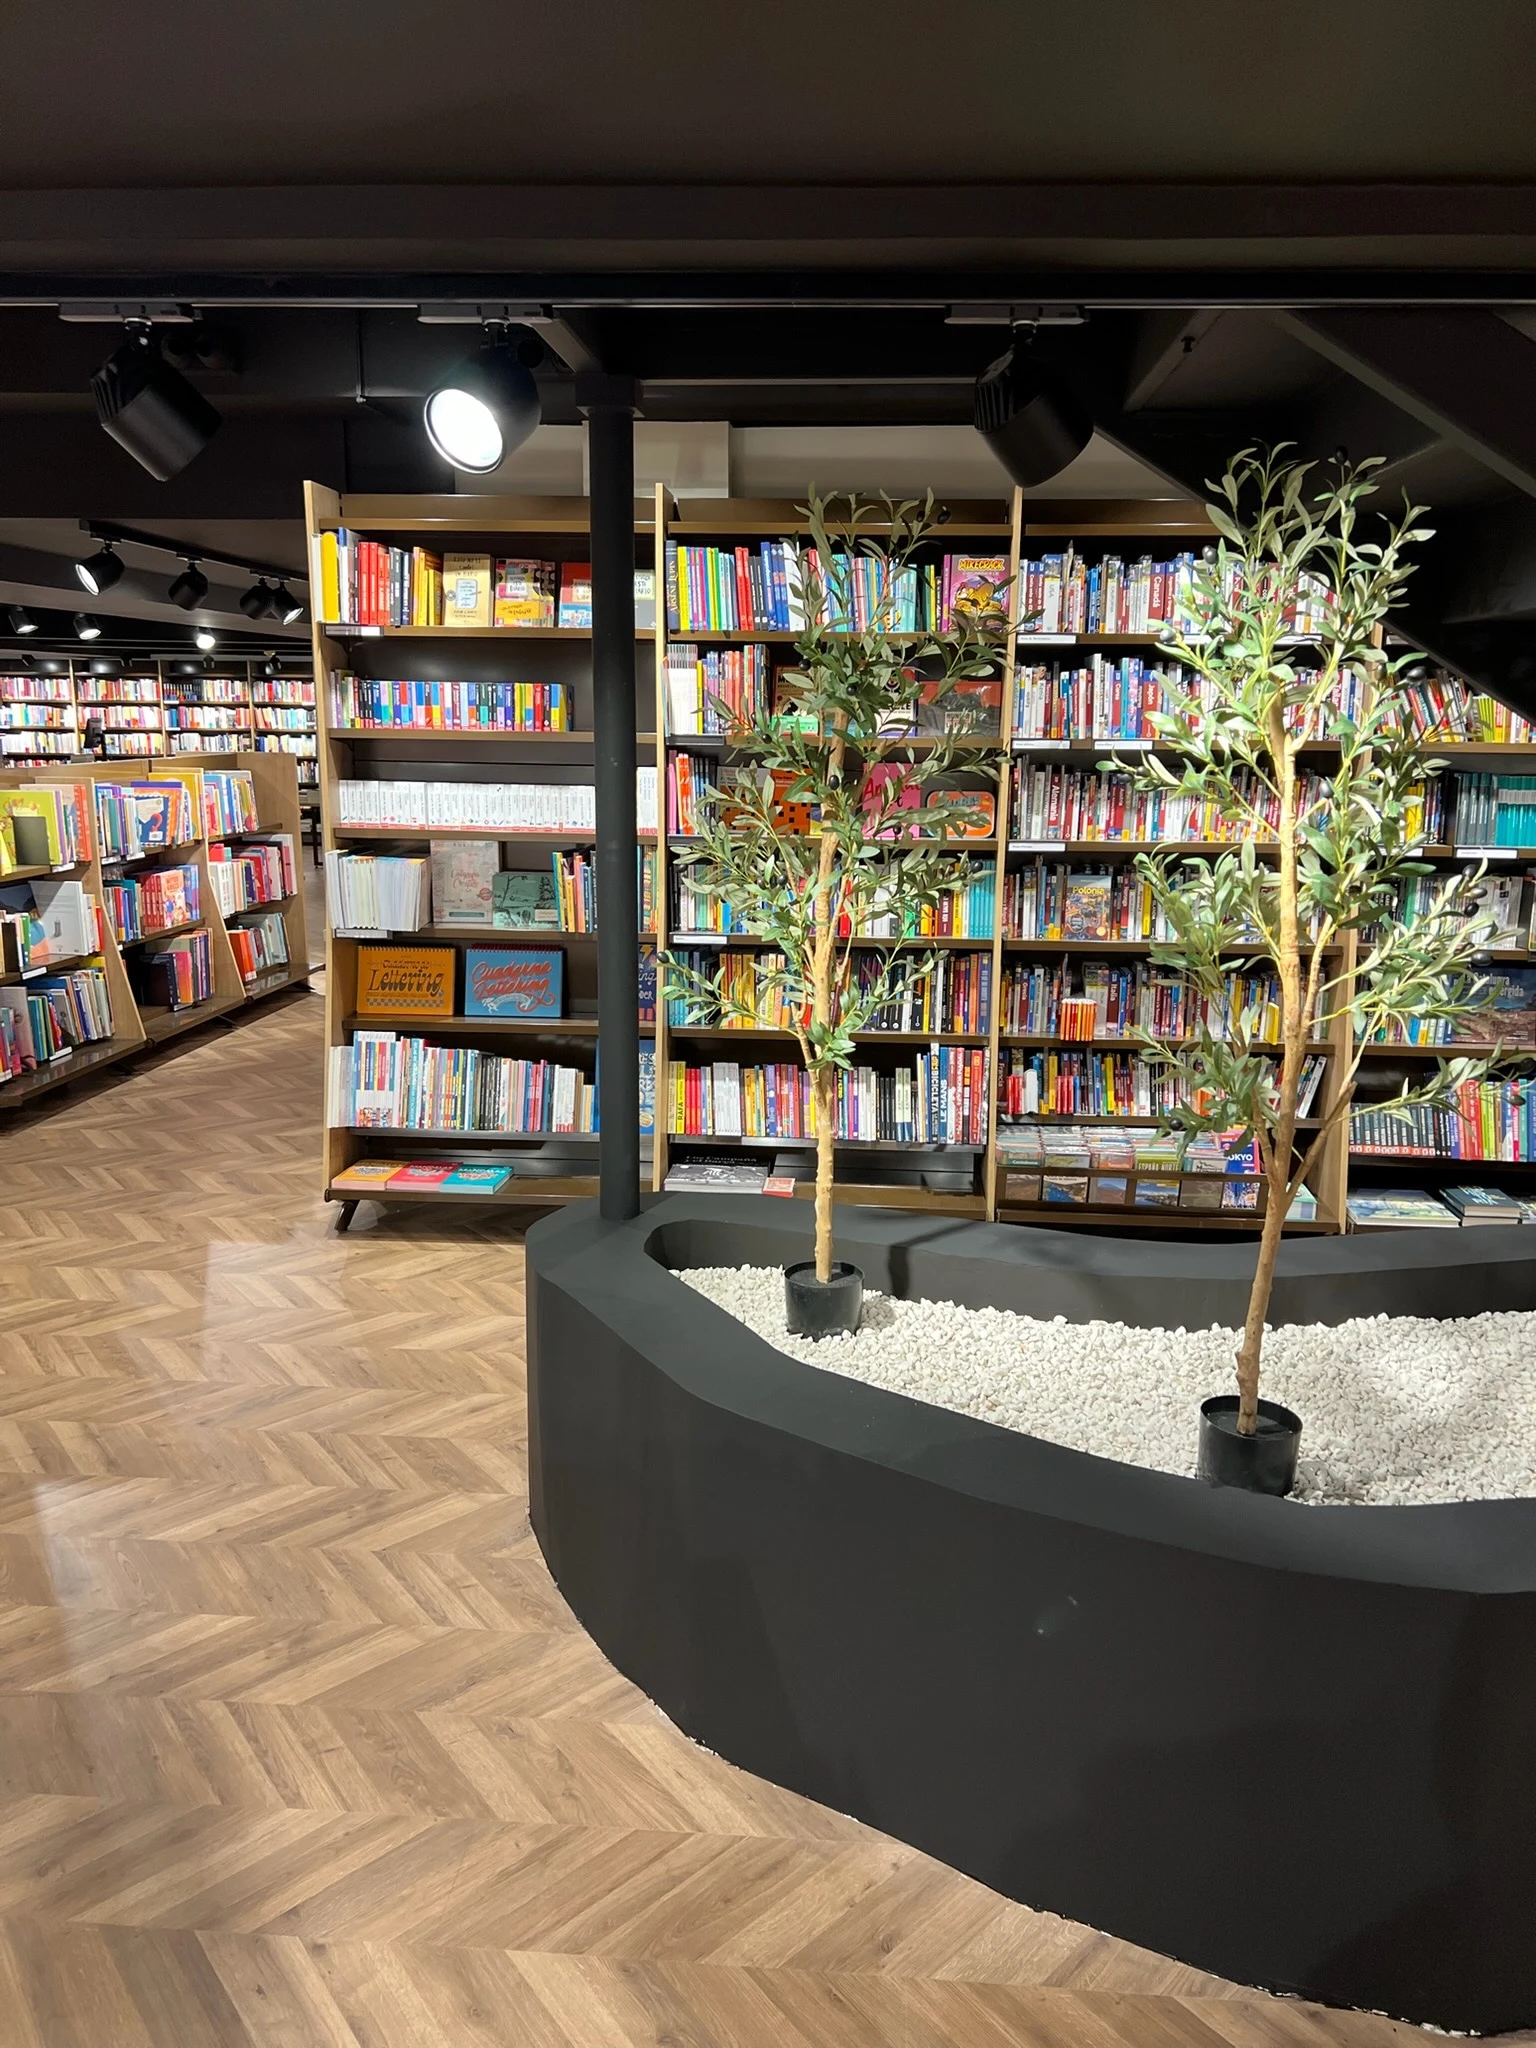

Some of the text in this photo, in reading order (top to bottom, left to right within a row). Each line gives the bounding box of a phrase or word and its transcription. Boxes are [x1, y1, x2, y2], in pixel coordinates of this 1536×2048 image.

[959, 559, 1004, 570] MIKECRACK
[1152, 576, 1162, 607] Canadá
[1147, 683, 1156, 705] Japón
[1050, 785, 1060, 821] Alemania
[1072, 886, 1105, 895] Polonia
[367, 968, 444, 997] Lettering
[1109, 983, 1118, 1001] Italia
[931, 1070, 939, 1114] BICICLETA
[940, 1079, 948, 1123] LE MANS
